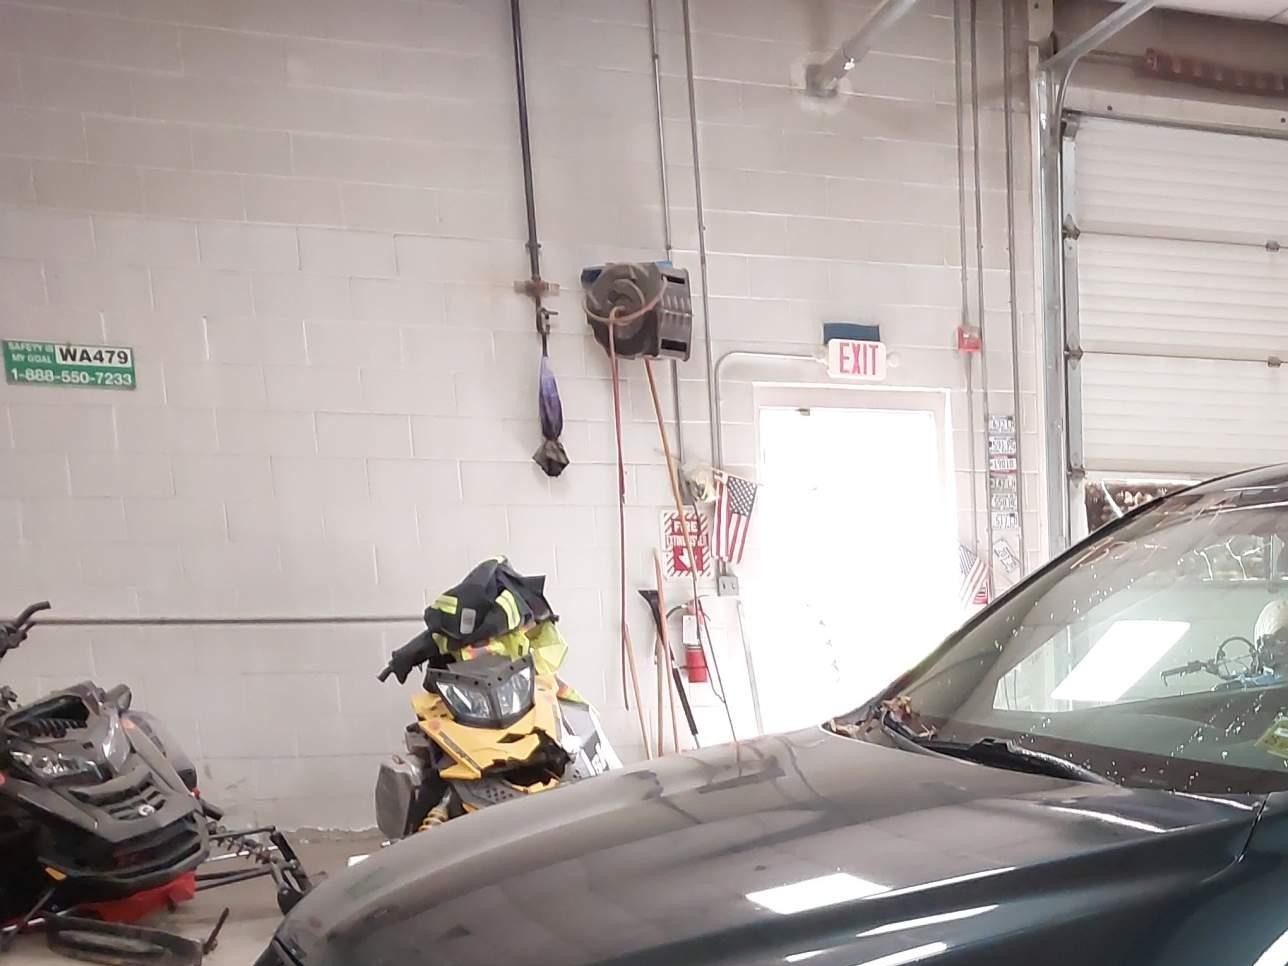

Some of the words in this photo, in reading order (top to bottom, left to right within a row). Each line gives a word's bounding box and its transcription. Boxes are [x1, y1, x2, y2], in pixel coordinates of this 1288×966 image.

[8, 341, 43, 352] SAFETY
[12, 353, 25, 361] MY
[27, 354, 52, 364] GOAL
[59, 347, 129, 365] WA479
[839, 342, 879, 376] EXIT
[11, 367, 132, 386] 1-888-550-7233
[673, 519, 698, 533] FRE
